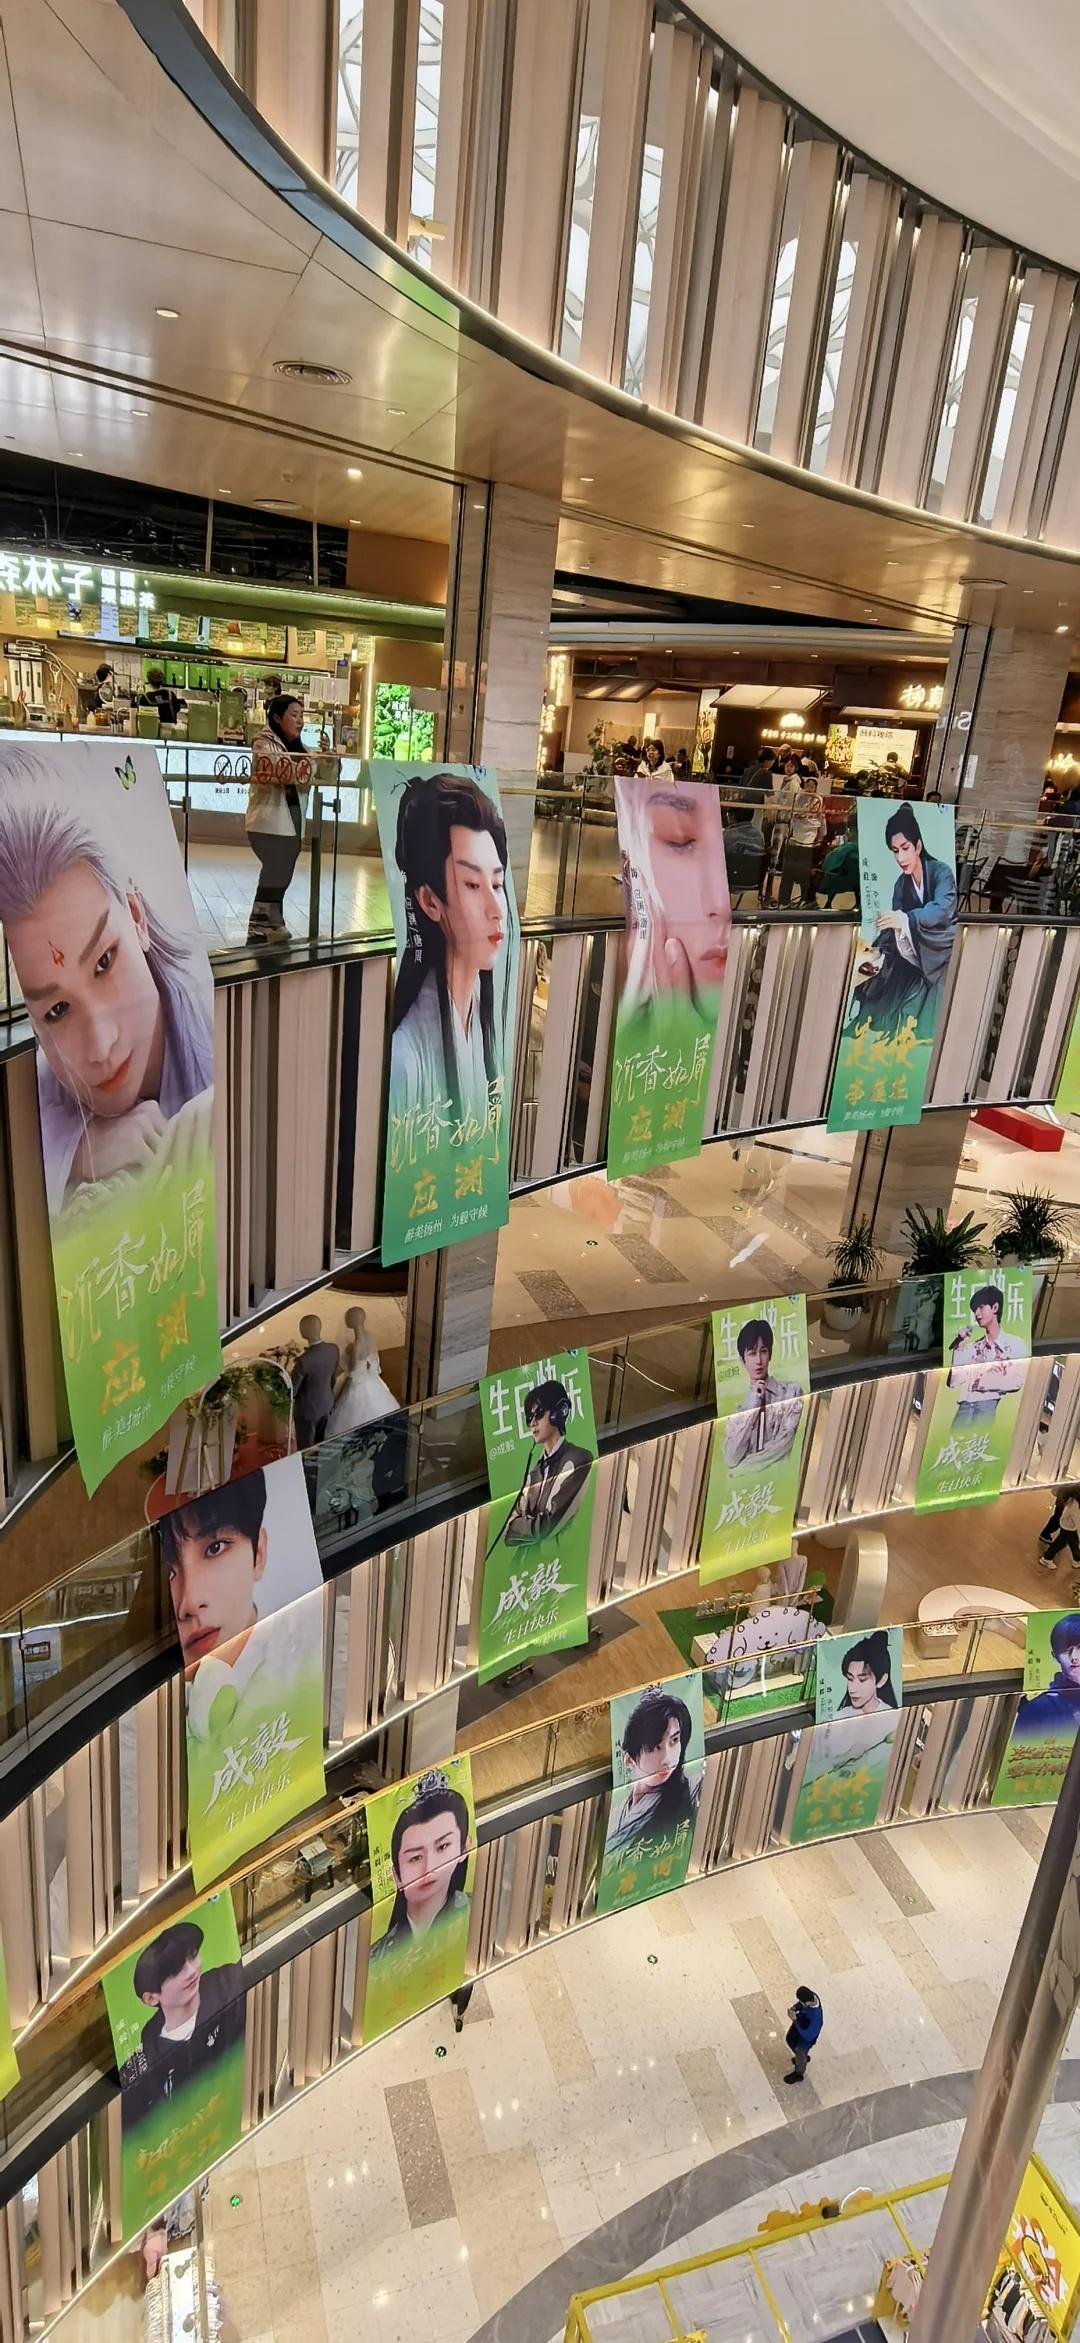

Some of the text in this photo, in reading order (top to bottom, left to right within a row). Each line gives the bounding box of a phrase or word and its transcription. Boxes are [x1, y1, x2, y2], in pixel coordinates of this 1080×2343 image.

[928, 1433, 1000, 1473] 成毅
[713, 1481, 784, 1533] 成毅
[482, 1558, 580, 1632] 成毅
[203, 1711, 312, 1816] 成毅
